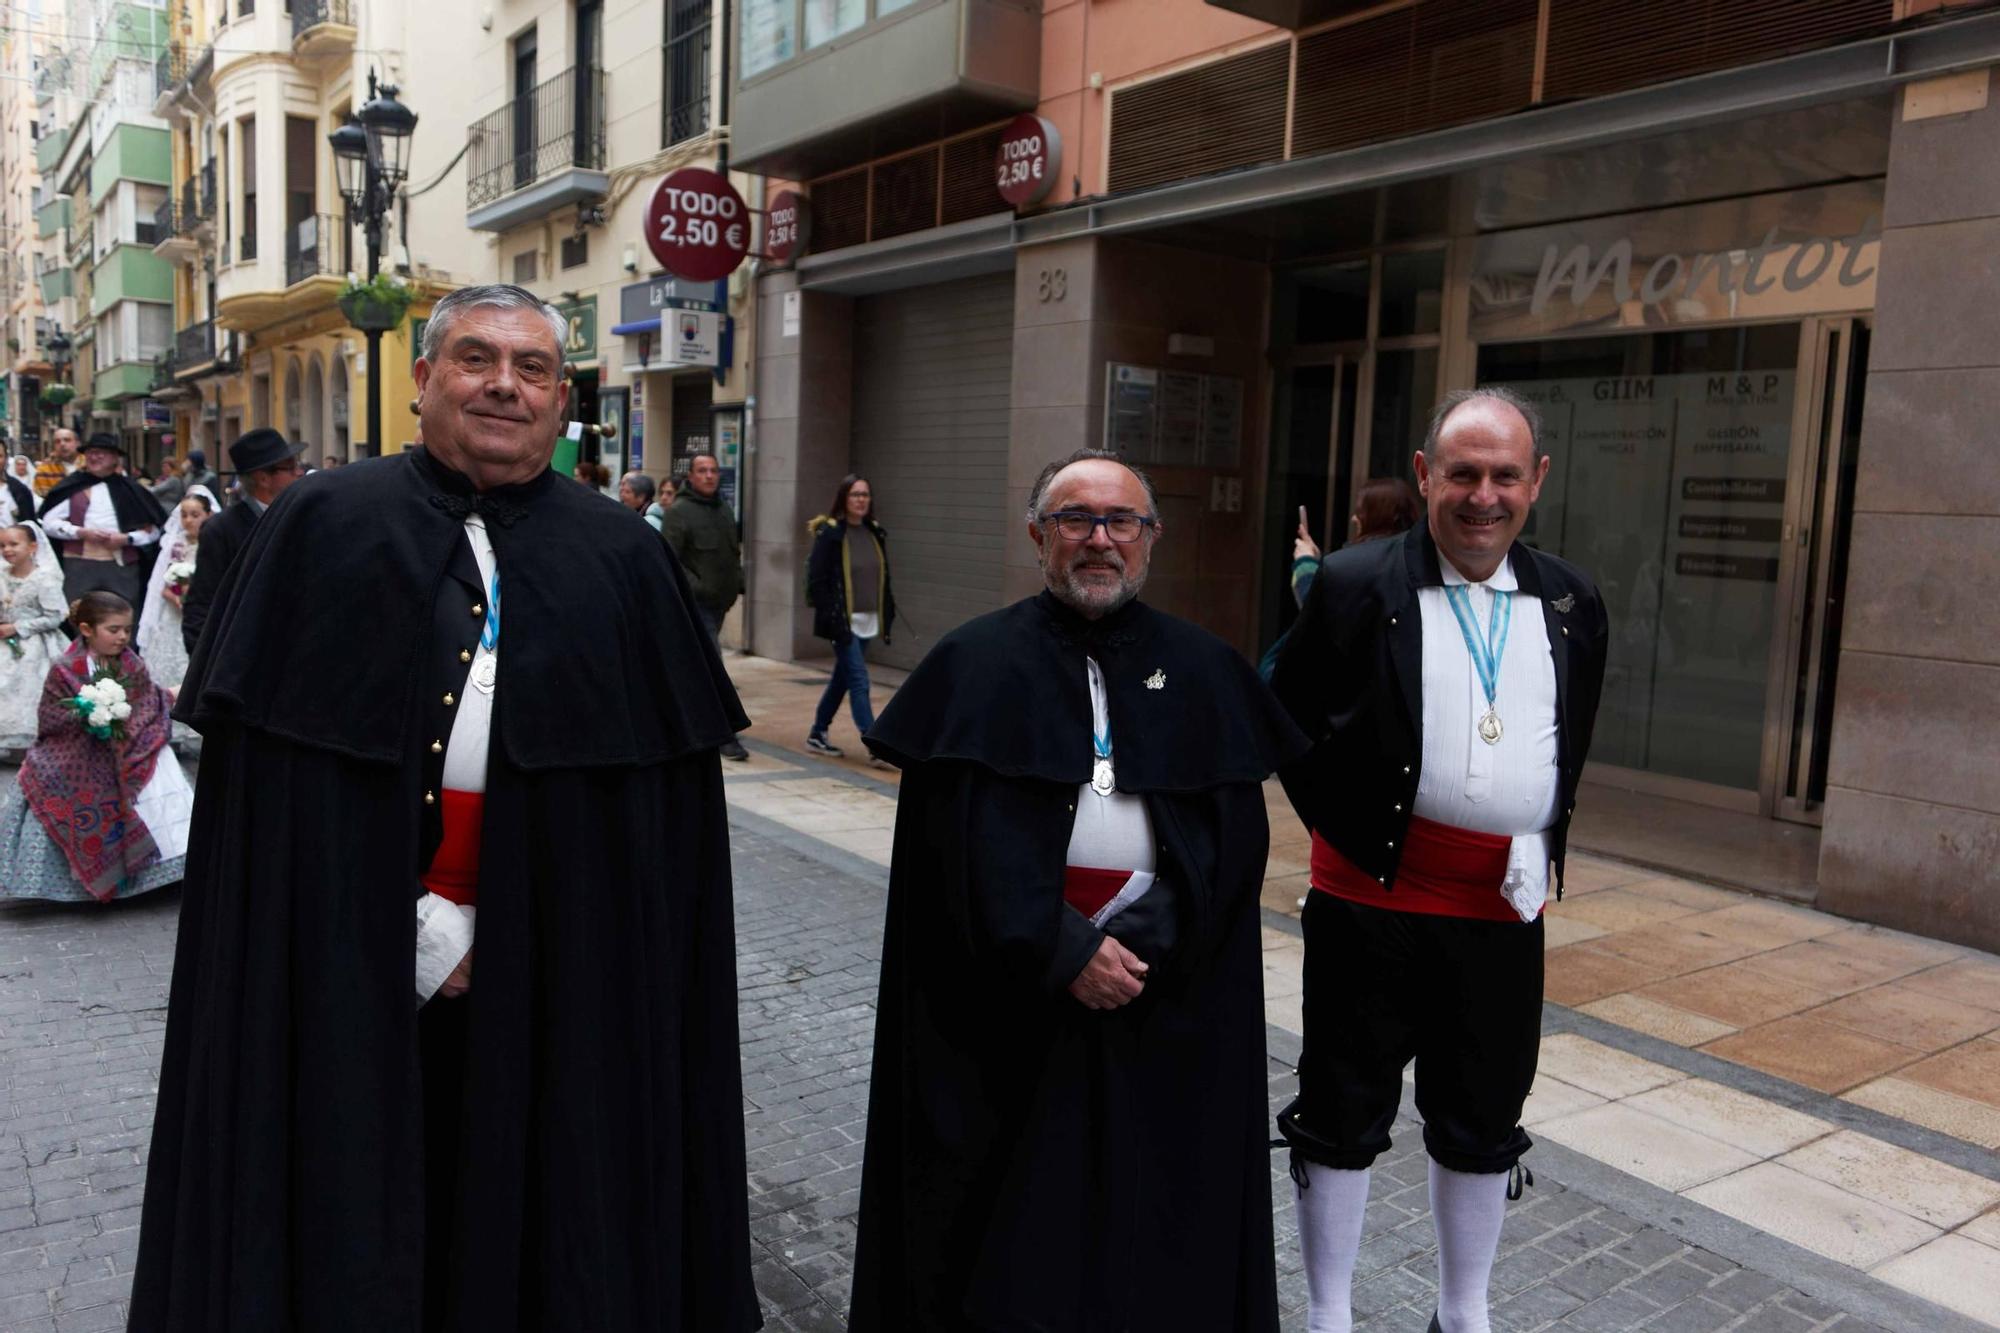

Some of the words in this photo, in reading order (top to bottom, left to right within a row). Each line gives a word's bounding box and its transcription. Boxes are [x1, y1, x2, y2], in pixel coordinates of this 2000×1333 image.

[1002, 135, 1041, 161] TODO
[996, 159, 1030, 188] 2,50
[1032, 155, 1043, 180] €
[666, 188, 737, 219] TODO
[770, 206, 796, 227] TODO
[659, 214, 718, 247] 2,50
[725, 223, 743, 250] €
[790, 224, 797, 241] €
[649, 285, 664, 306] La
[1038, 266, 1067, 304] 83
[1593, 377, 1655, 401] GIIM
[1707, 376, 1727, 396] M
[1736, 374, 1752, 395] &
[1763, 374, 1779, 394] P
